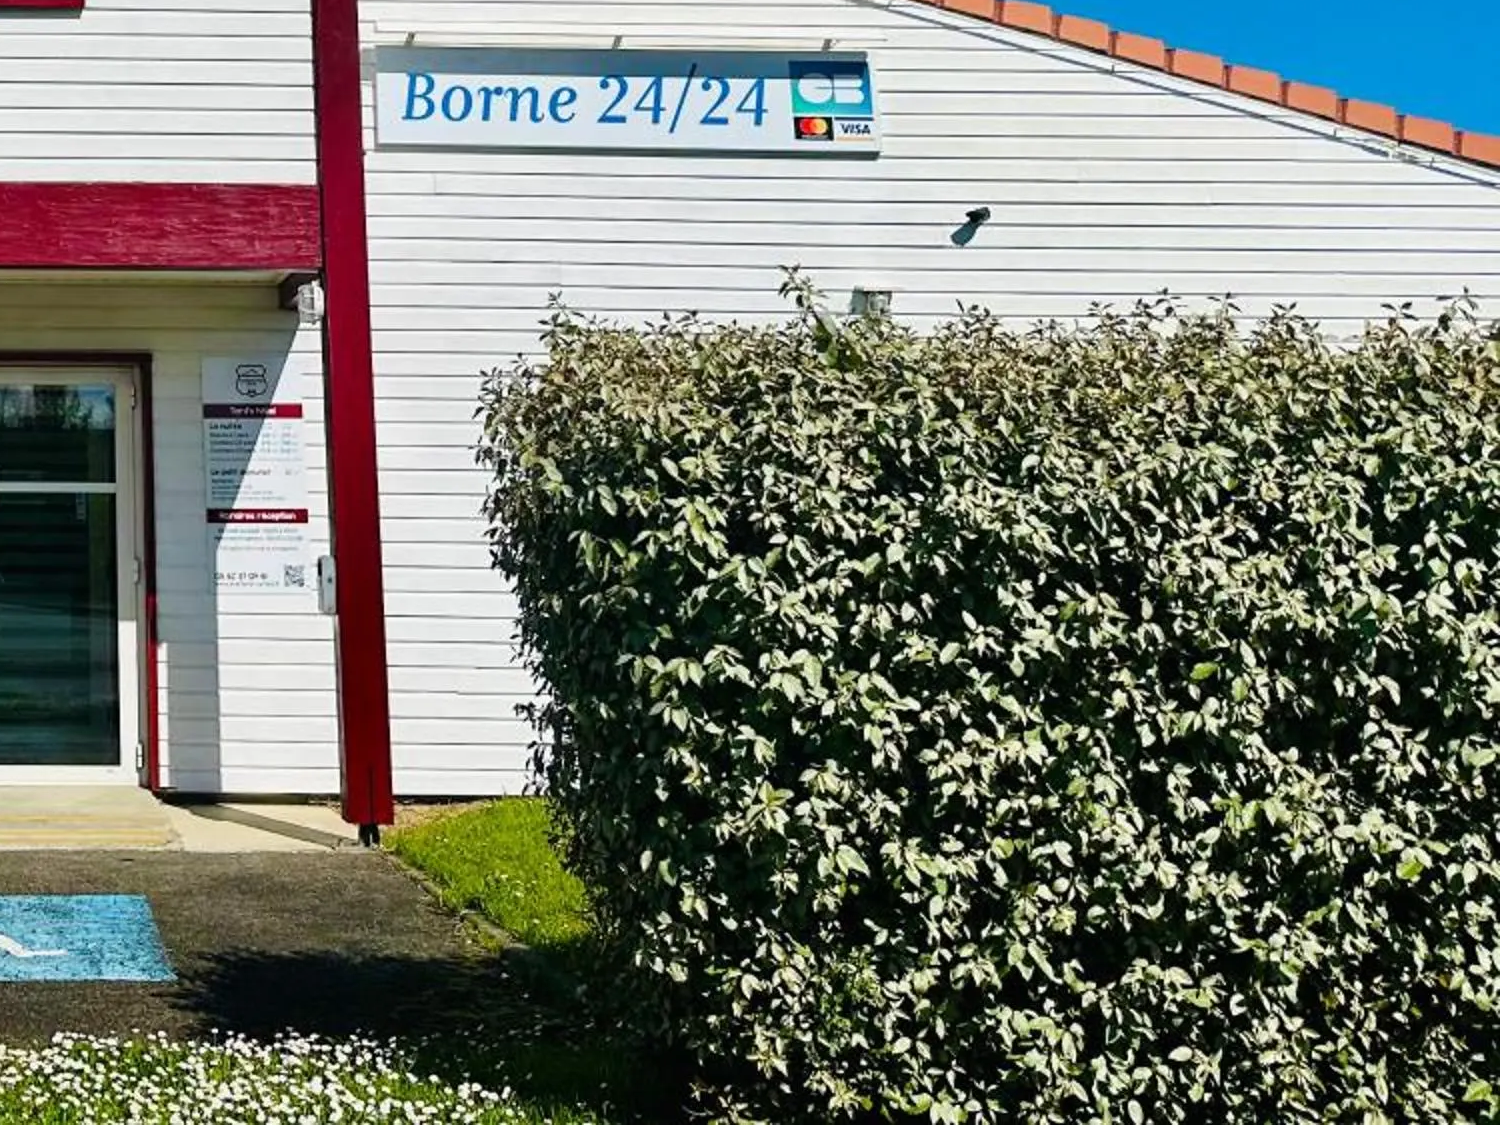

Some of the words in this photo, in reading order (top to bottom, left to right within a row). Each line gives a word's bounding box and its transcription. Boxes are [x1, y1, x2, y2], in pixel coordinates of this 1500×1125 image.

[401, 70, 578, 123] Borne
[597, 62, 769, 134] 24/24
[840, 122, 871, 135] VISA
